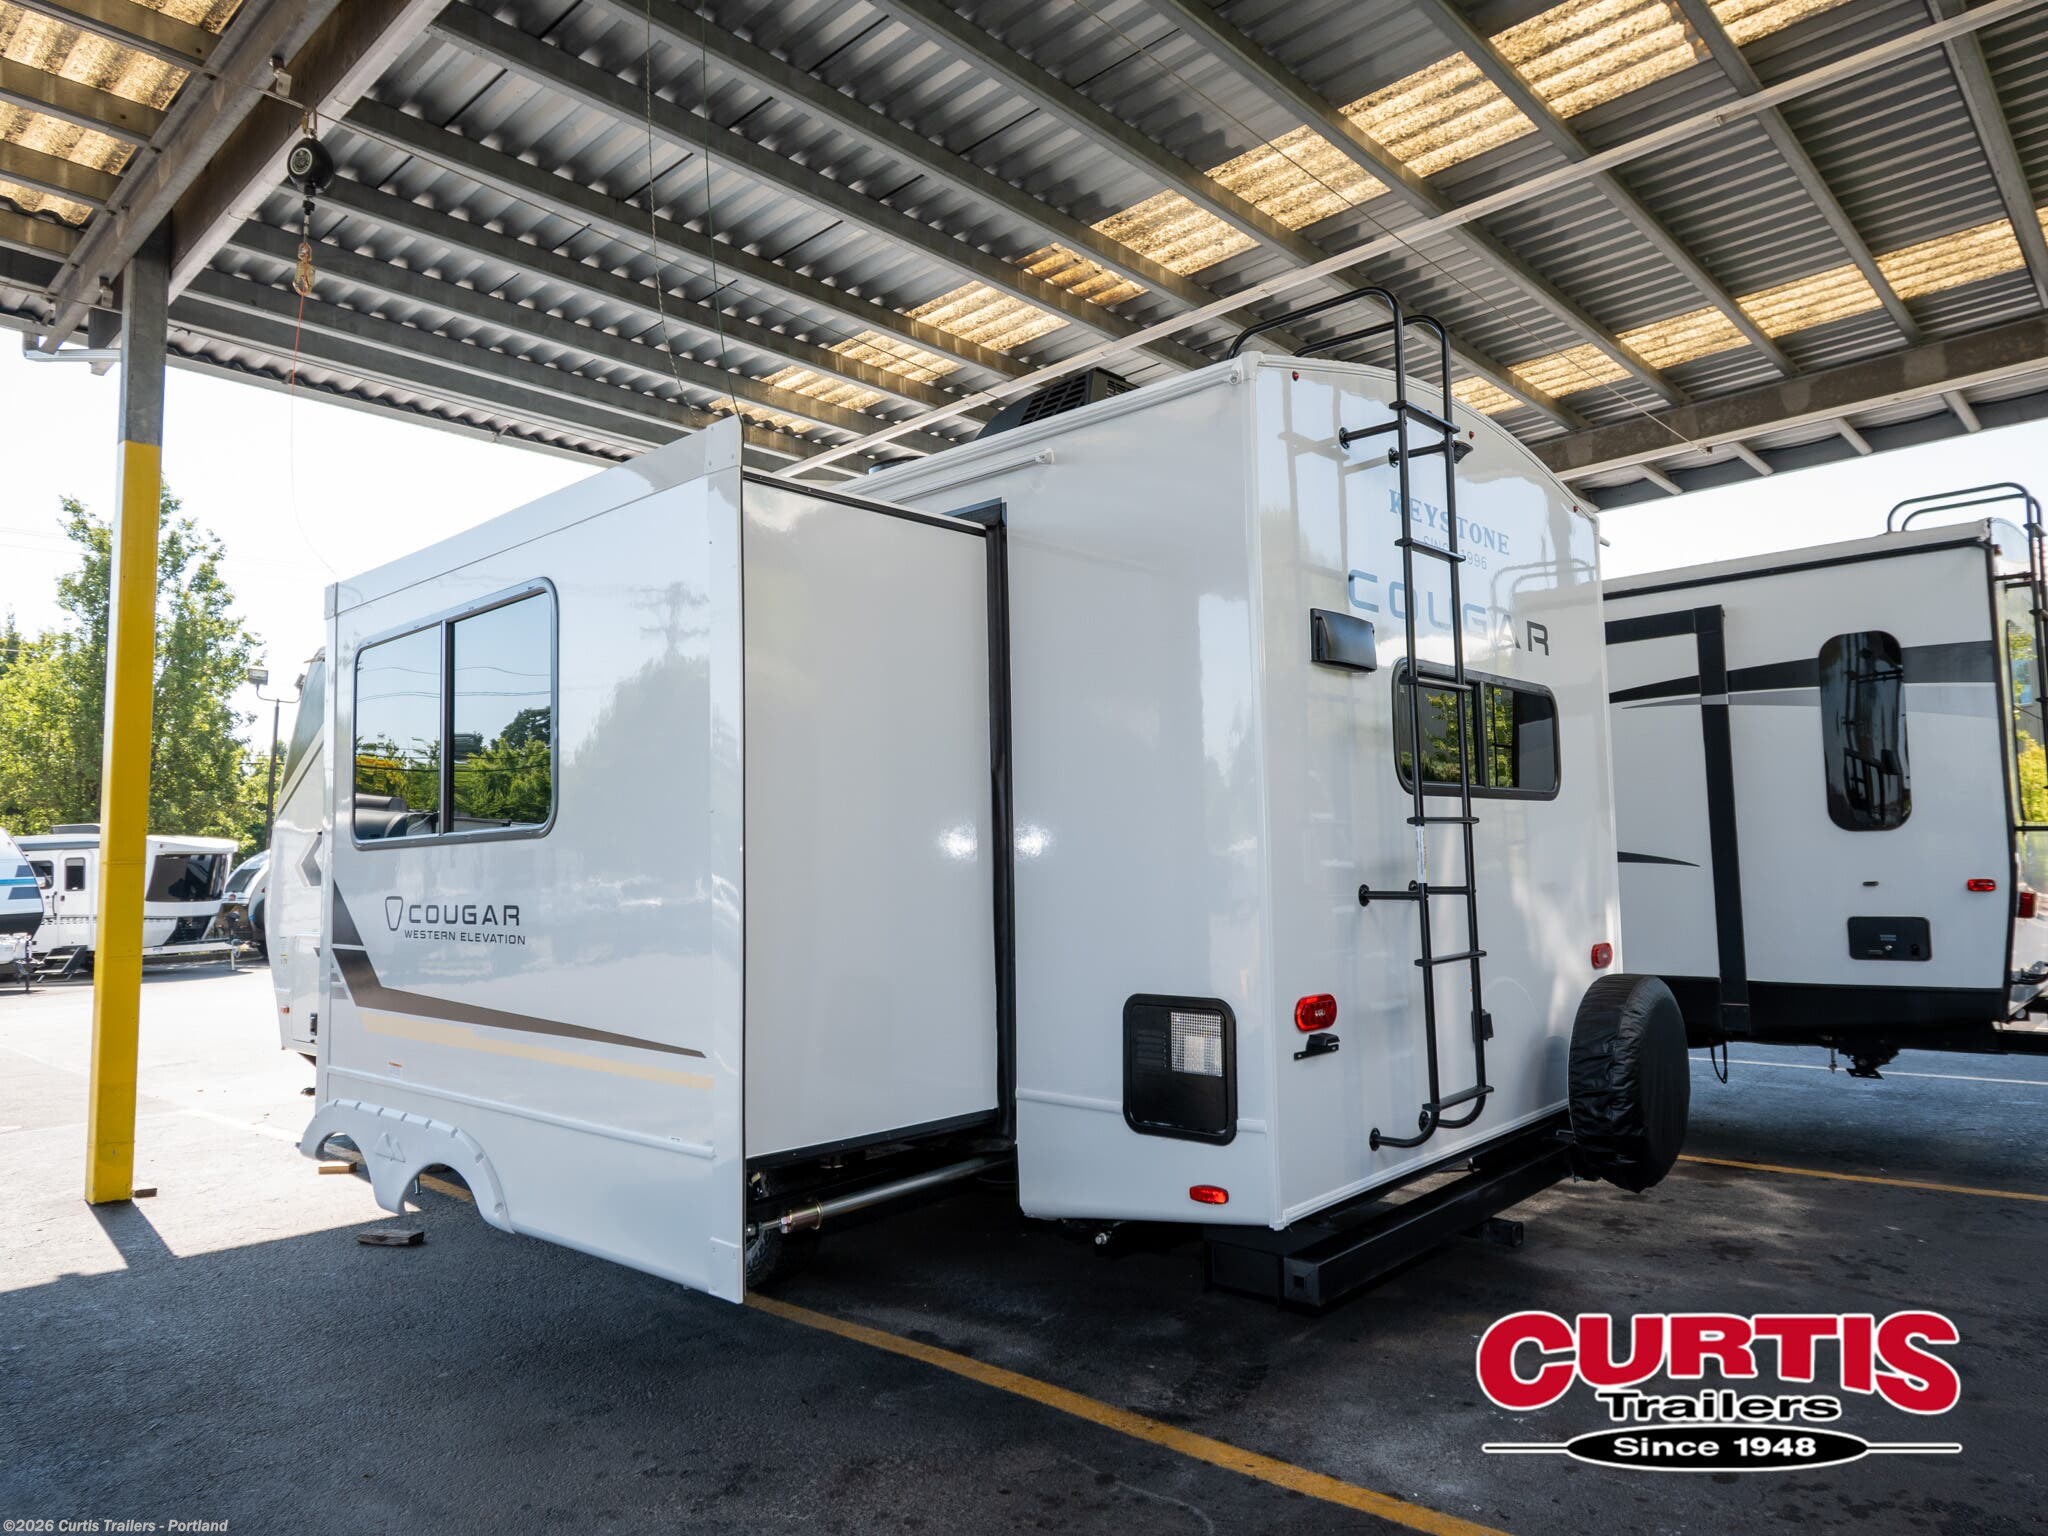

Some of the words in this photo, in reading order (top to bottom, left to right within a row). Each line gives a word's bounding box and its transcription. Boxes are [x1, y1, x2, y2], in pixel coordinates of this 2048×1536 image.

[1348, 569, 1549, 656] COUGAR
[408, 904, 520, 926] COUGAR
[404, 930, 456, 941] WESTERN
[460, 932, 526, 945] ELEVATION
